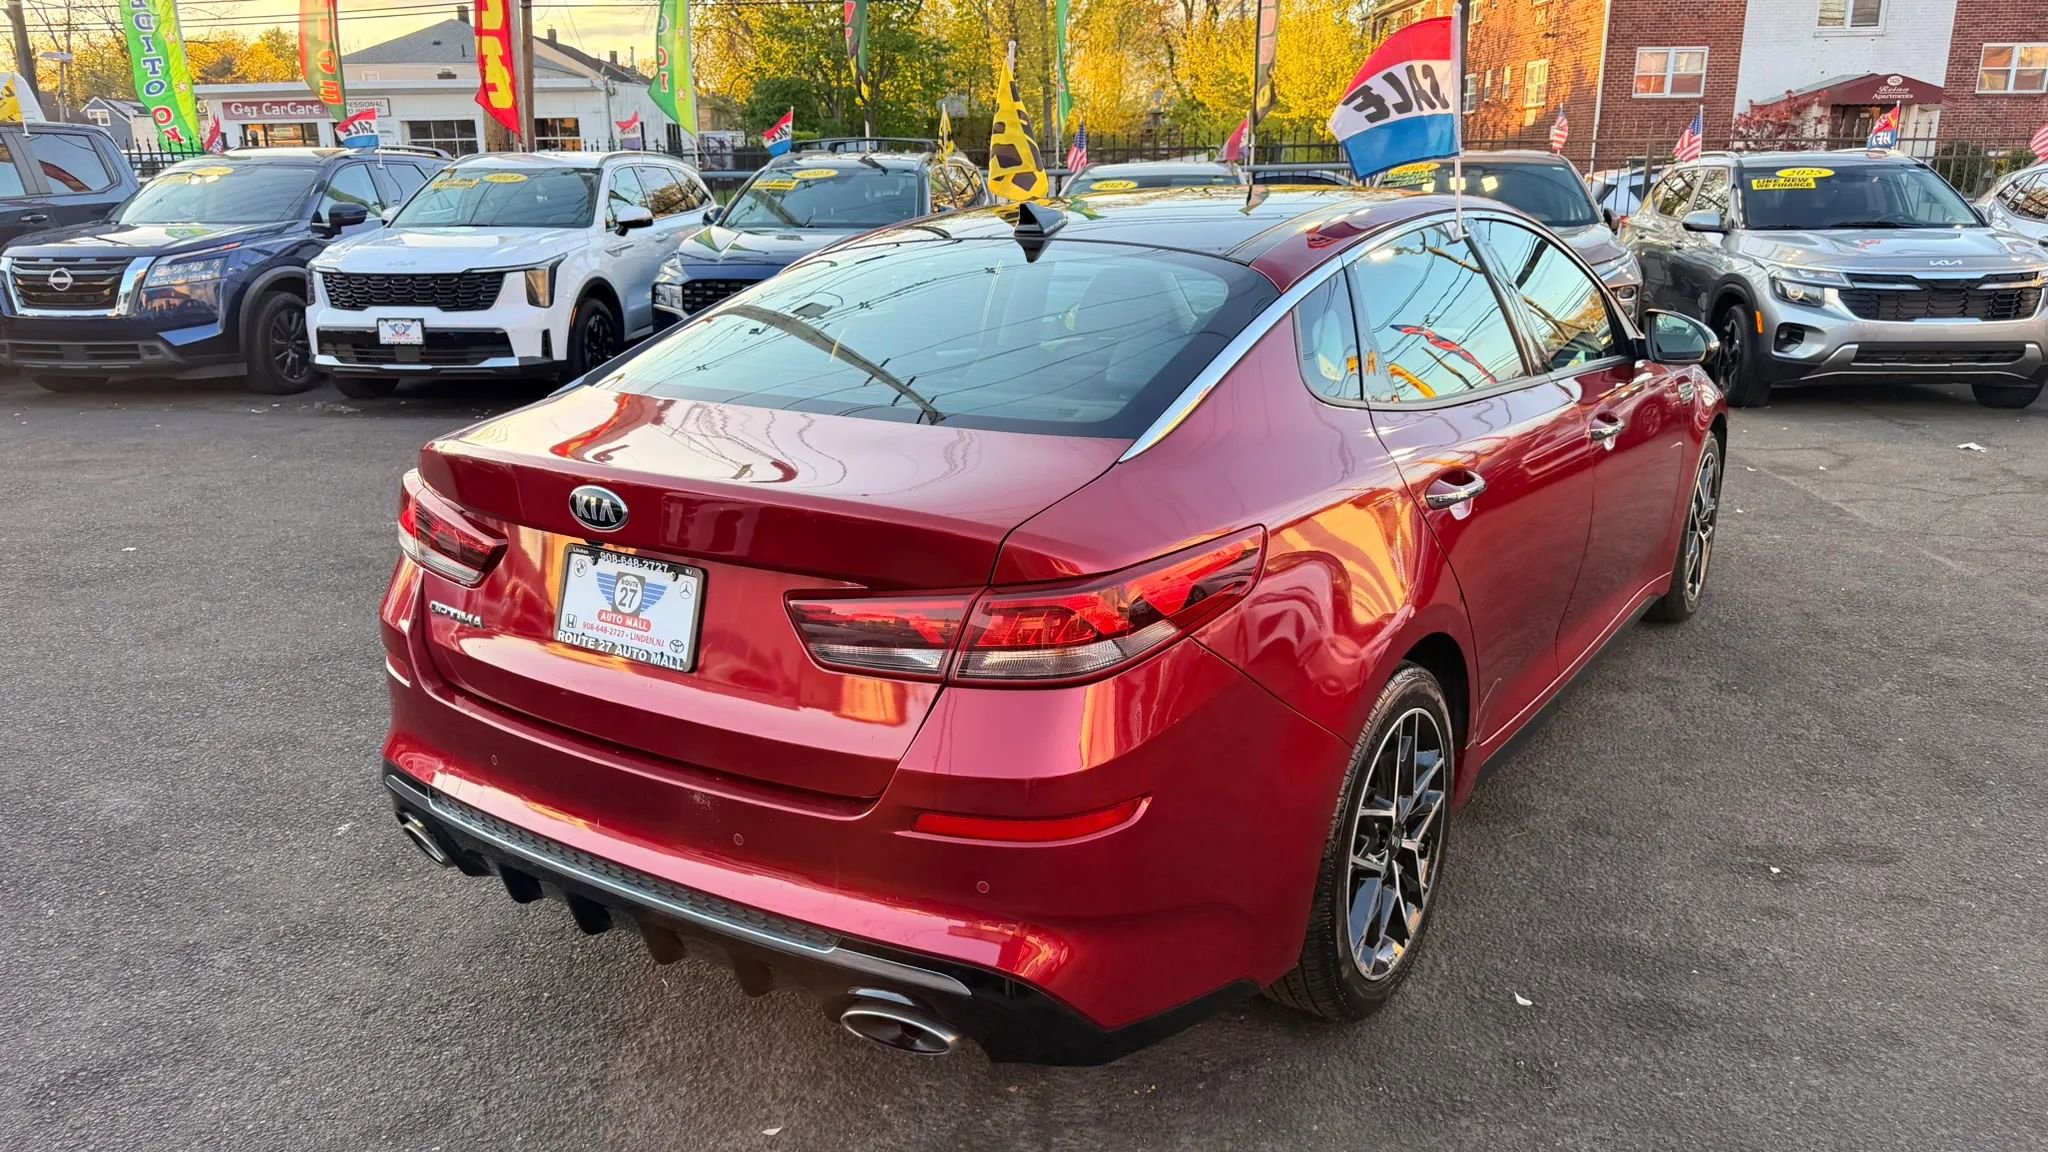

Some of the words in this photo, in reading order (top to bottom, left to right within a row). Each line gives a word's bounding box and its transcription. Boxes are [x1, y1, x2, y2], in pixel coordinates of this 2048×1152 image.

[262, 102, 321, 116] CarCare
[575, 494, 617, 523] KIA
[599, 551, 670, 574] 908-648-2727
[621, 579, 639, 588] ROUTE
[618, 588, 638, 609] 27
[429, 600, 486, 630] OPTIMA
[600, 611, 623, 625] AUTO
[625, 616, 649, 630] MALL
[582, 621, 625, 637] 908-648-2727
[557, 630, 596, 649] ROUTE
[599, 640, 612, 653] 27
[615, 644, 648, 661] AUTO
[650, 652, 685, 671] MALL
